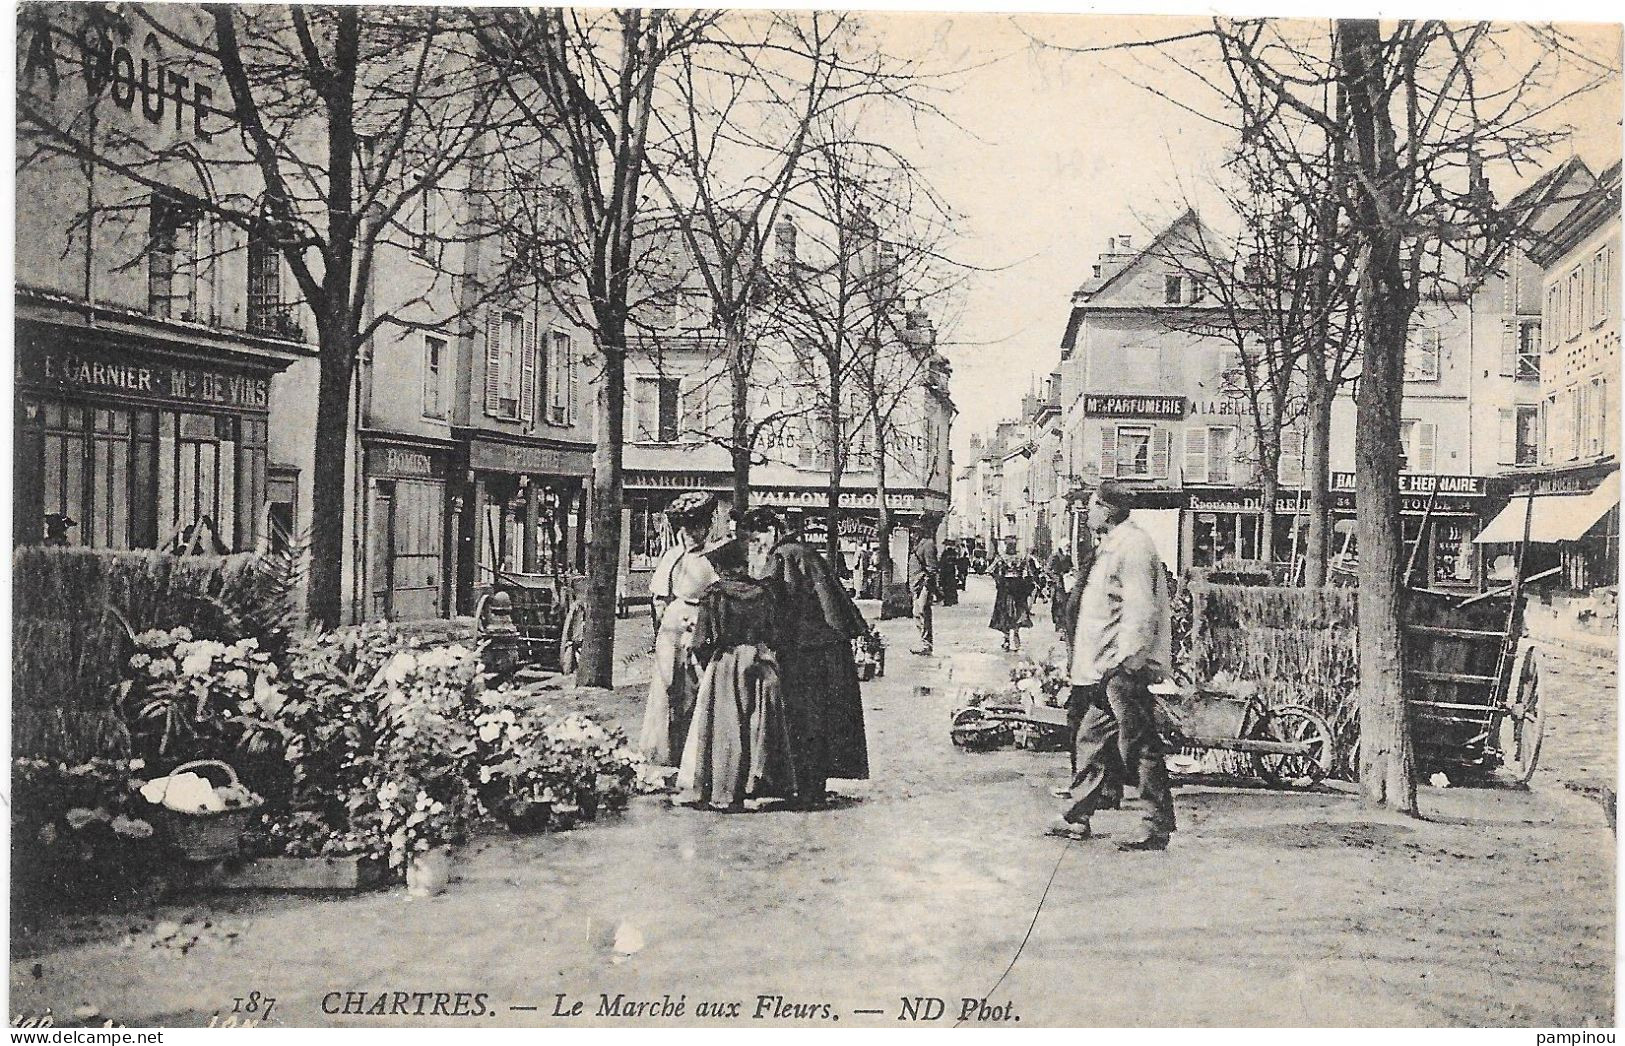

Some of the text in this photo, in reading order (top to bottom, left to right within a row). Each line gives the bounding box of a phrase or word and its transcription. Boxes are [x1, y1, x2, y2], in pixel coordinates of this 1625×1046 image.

[64, 357, 151, 391] GARNIER
[203, 371, 225, 402] DE
[229, 375, 266, 406] VINS
[1107, 398, 1182, 414] PARFUMERIE
[1411, 476, 1477, 492] HERNIAIRE
[804, 533, 828, 543] TABAC
